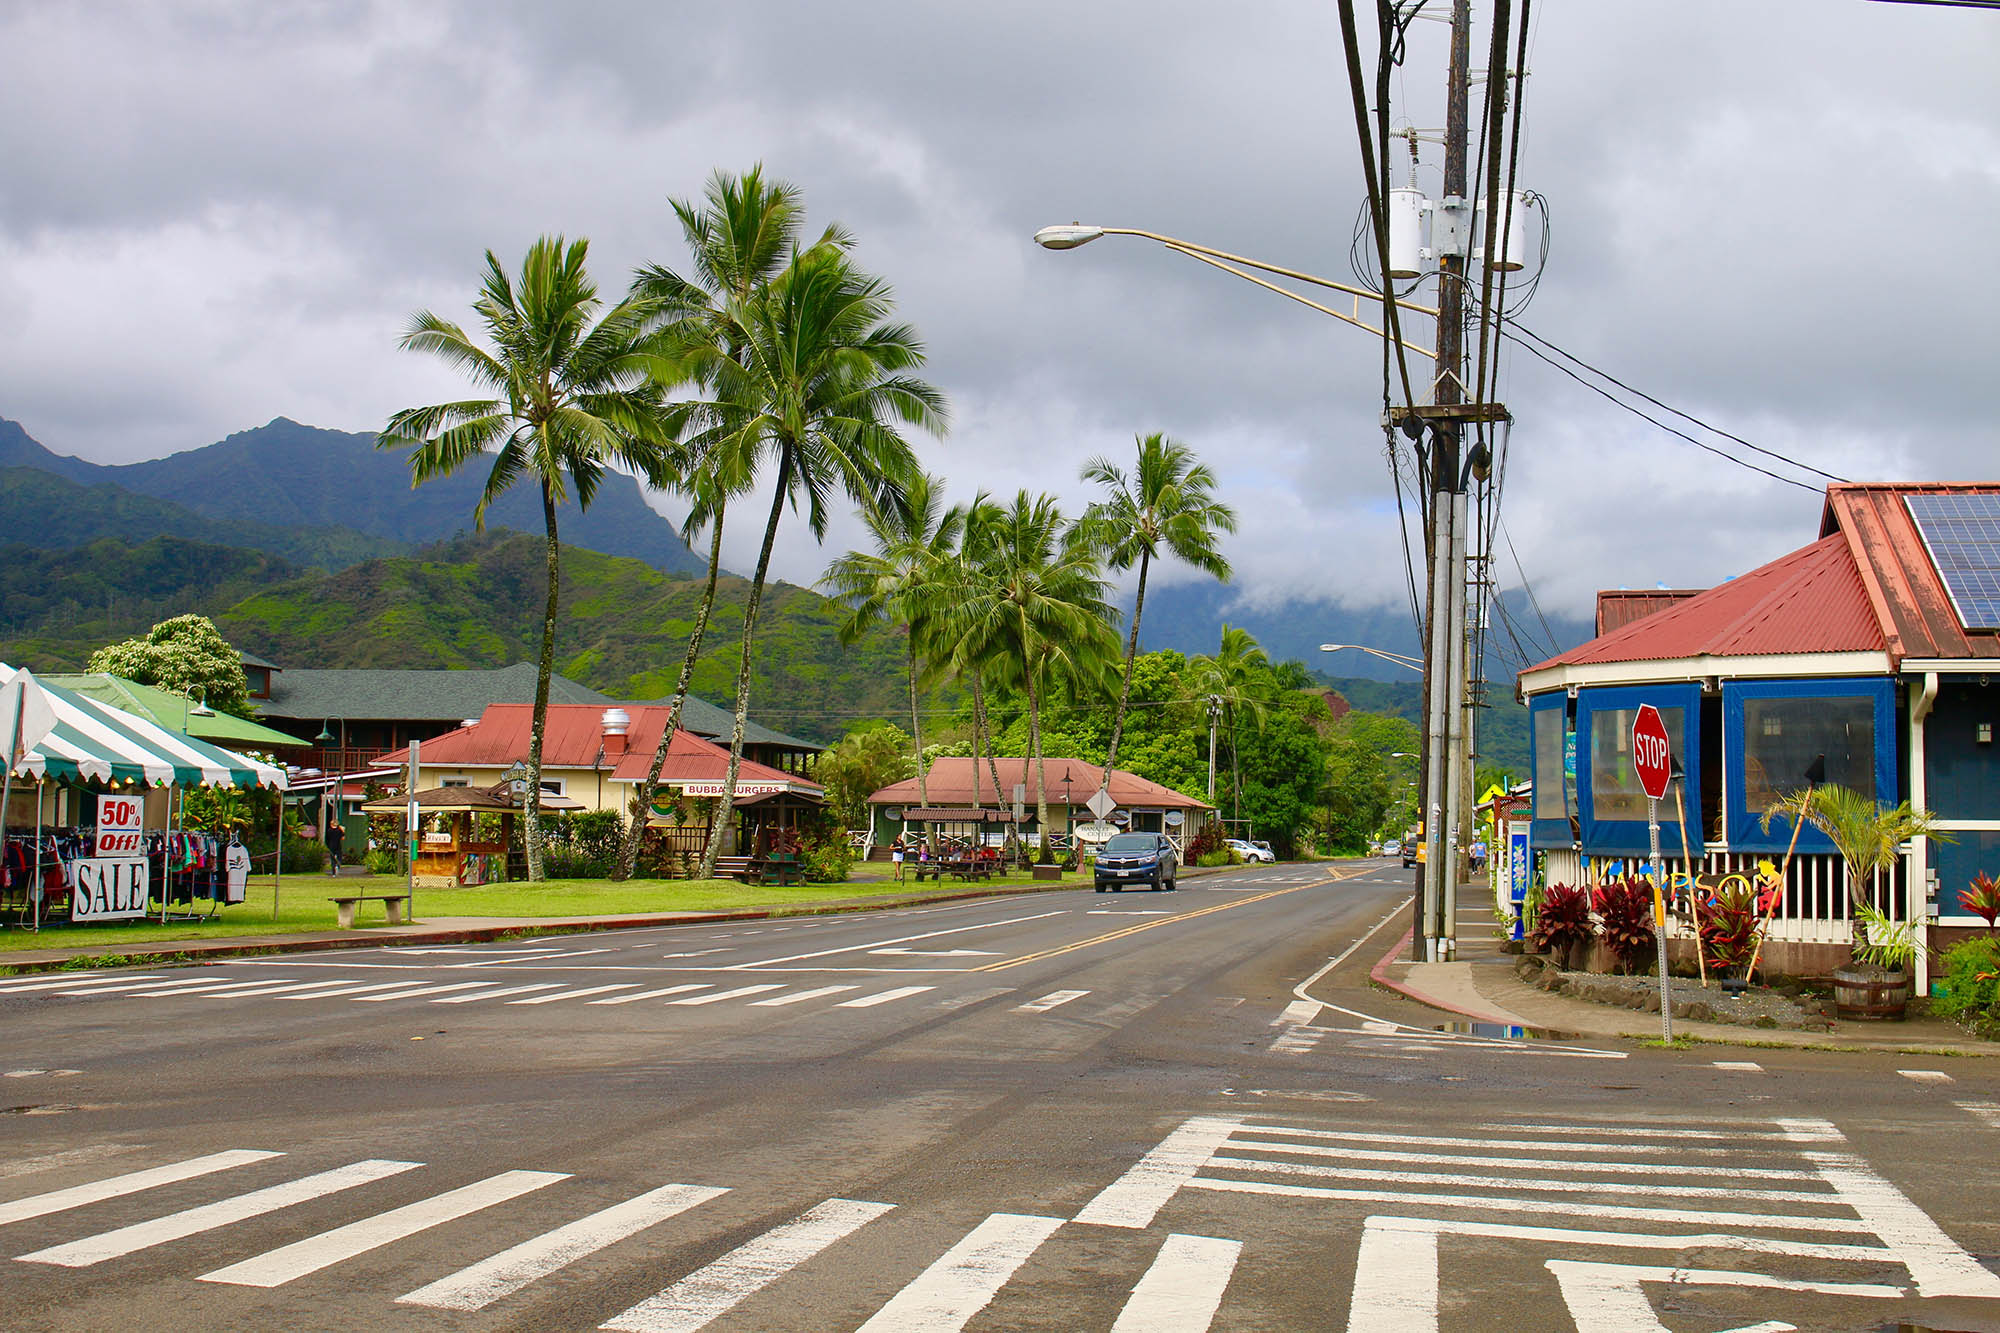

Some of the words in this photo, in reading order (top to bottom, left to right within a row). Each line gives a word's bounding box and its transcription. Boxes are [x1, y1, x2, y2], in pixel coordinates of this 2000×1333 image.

[1636, 732, 1667, 770] STOP
[689, 785, 725, 794] BUBBA
[101, 800, 141, 826] 50%
[99, 834, 141, 851] Off!
[77, 863, 145, 915] SALE
[1591, 857, 1752, 910] KAYPSO
